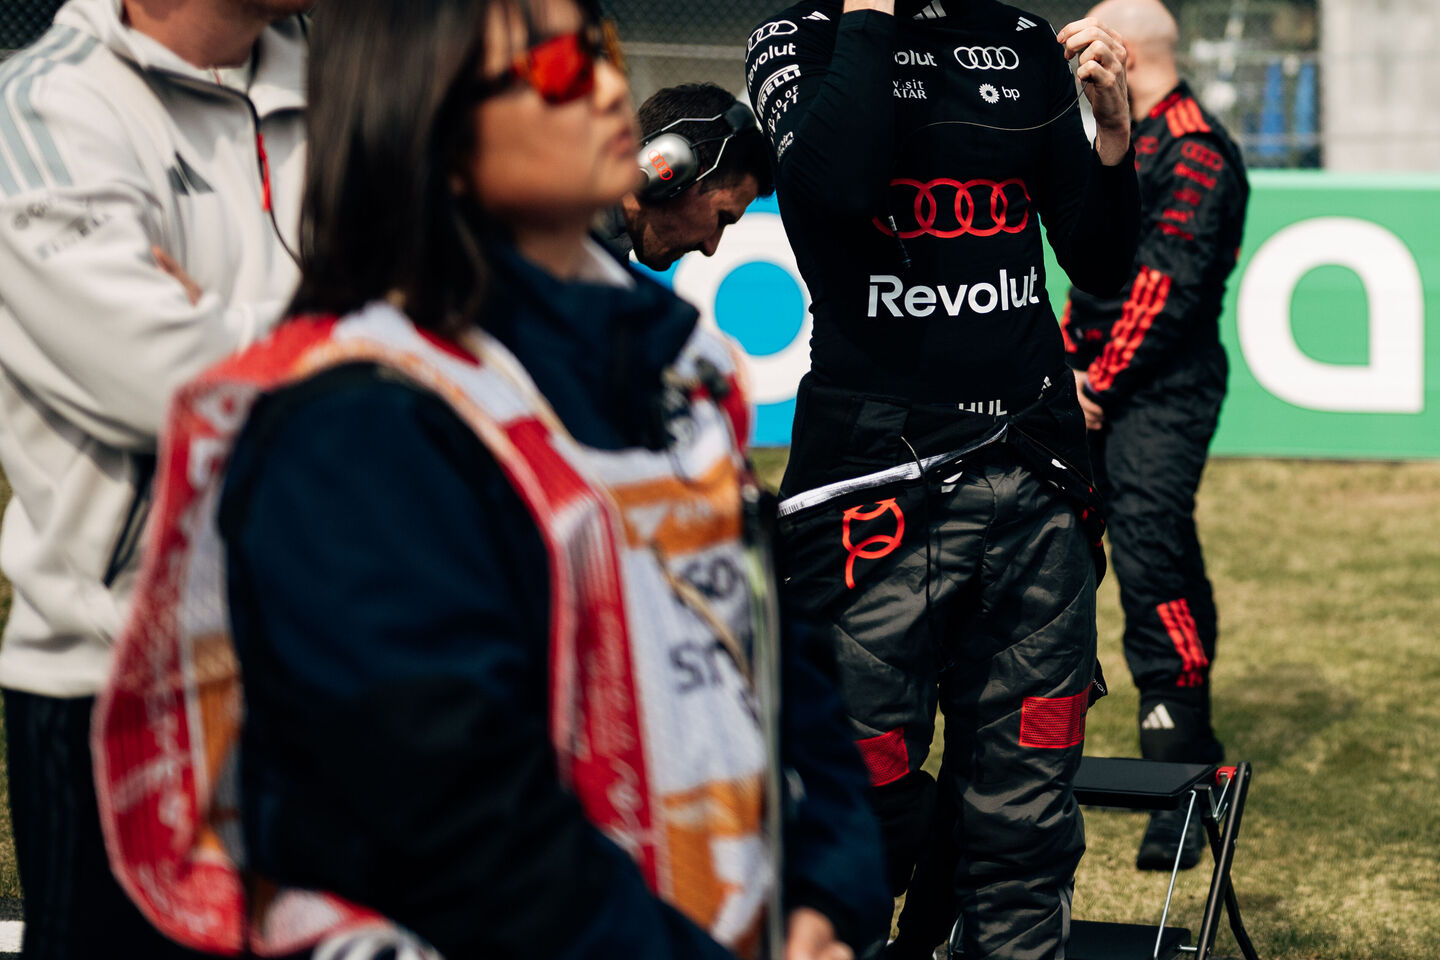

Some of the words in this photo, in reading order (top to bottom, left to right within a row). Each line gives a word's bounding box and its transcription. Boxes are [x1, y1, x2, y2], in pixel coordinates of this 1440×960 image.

[894, 49, 938, 67] olut
[1001, 85, 1021, 101] bp
[867, 265, 1041, 318] Revolut
